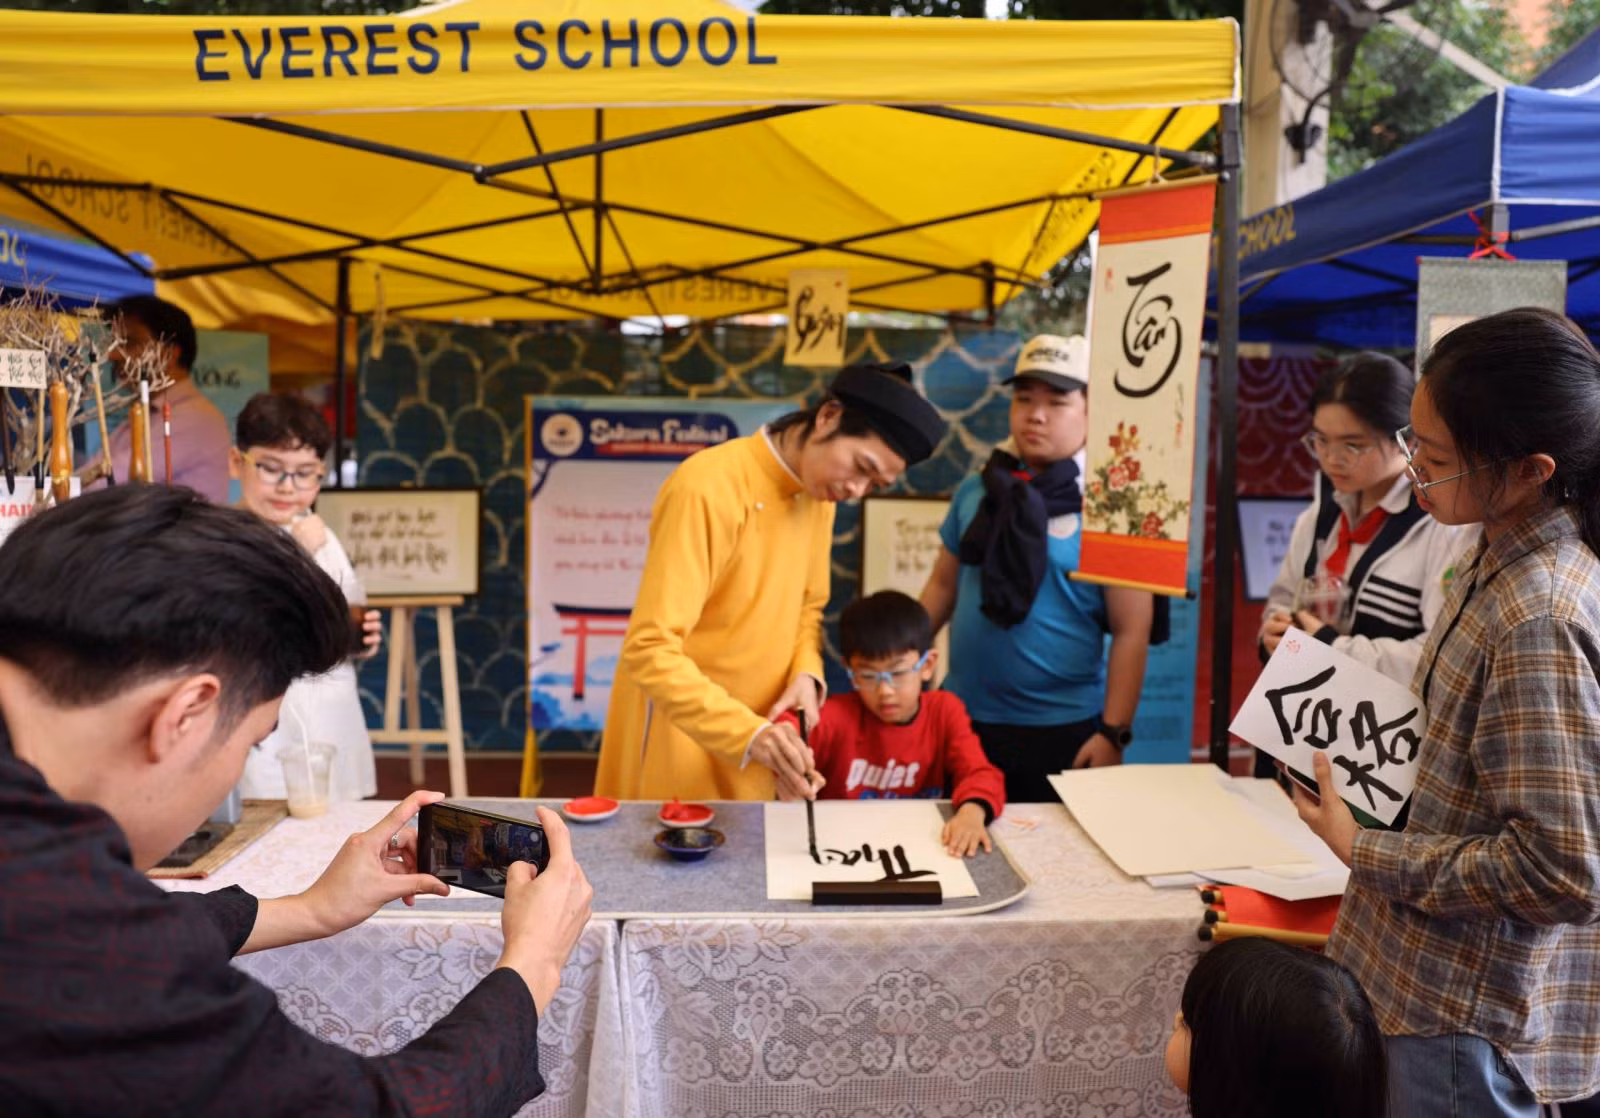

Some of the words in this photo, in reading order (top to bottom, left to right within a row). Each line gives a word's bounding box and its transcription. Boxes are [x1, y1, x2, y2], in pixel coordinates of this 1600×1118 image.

[193, 22, 480, 81] EVEREST
[514, 16, 778, 71] SCHOOL
[1236, 201, 1297, 262] CHOOL
[1264, 665, 1422, 811] 合格
